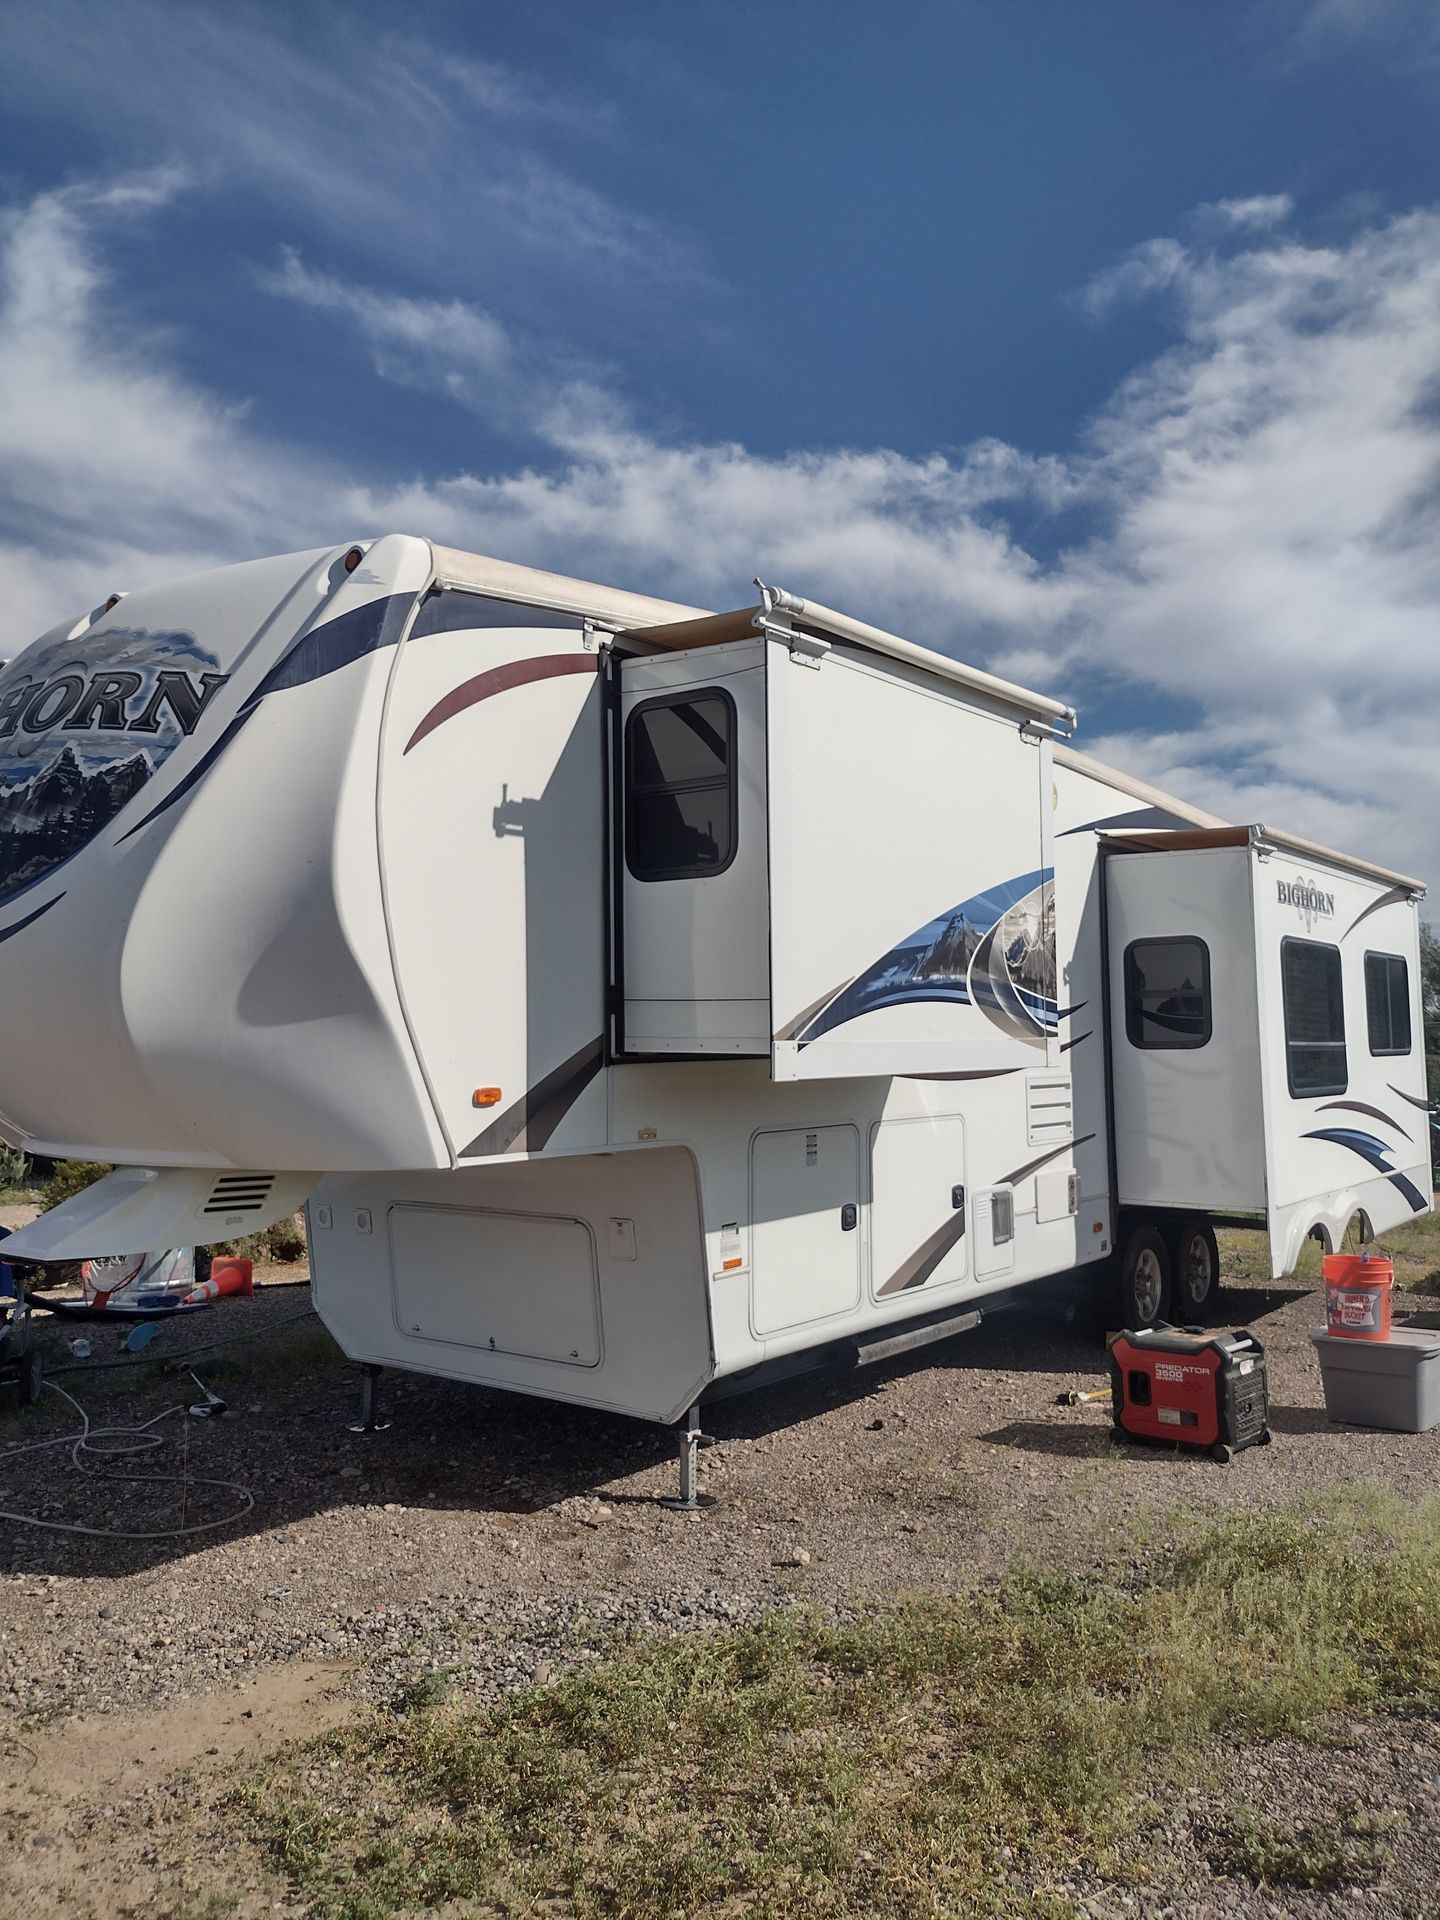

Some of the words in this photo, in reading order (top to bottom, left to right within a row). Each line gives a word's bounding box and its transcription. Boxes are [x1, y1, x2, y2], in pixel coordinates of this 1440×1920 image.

[1276, 880, 1335, 916] BIGHORN
[1155, 1363, 1211, 1375] PREDATOR
[1155, 1369, 1183, 1379] 3500
